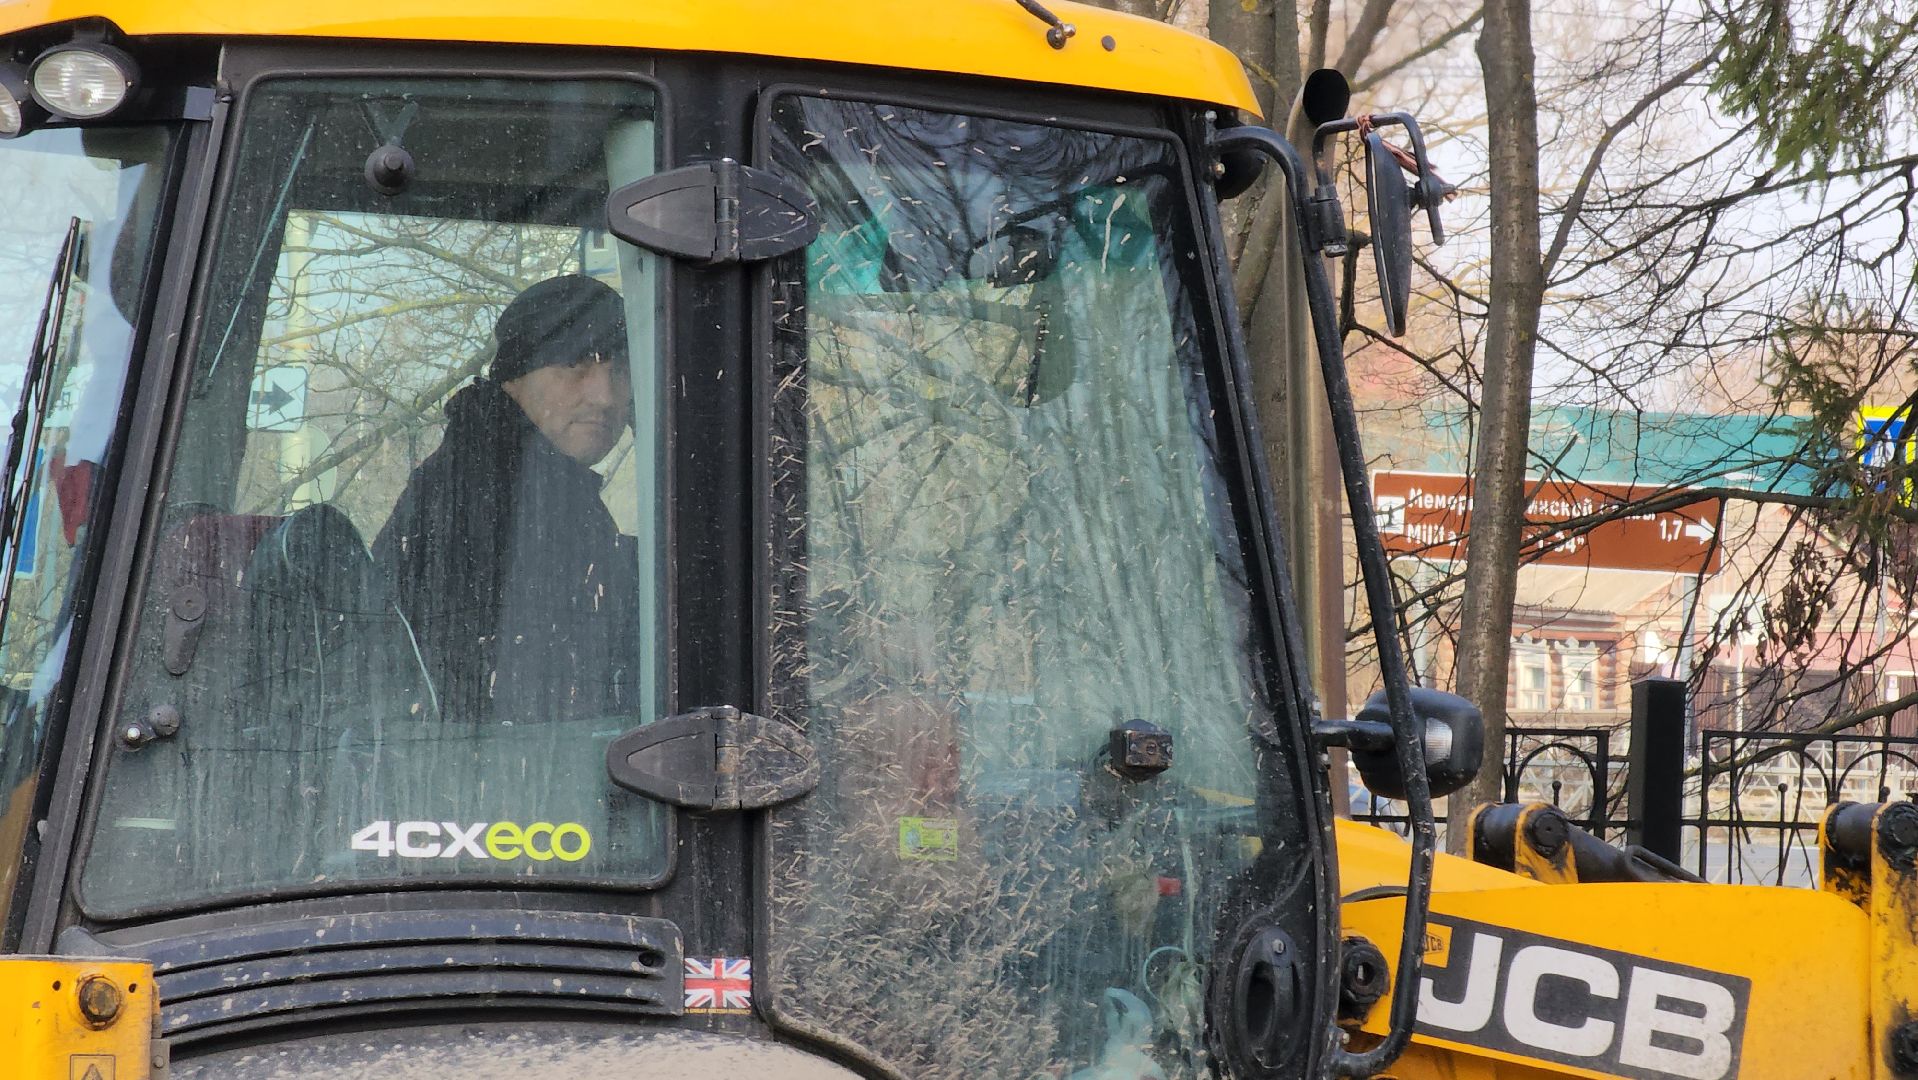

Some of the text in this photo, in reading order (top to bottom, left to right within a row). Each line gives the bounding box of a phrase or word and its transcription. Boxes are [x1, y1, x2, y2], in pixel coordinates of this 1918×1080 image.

[1660, 518, 1683, 542] 1,7
[351, 820, 592, 862] 4CXeco
[1416, 932, 1736, 1080] JCB
